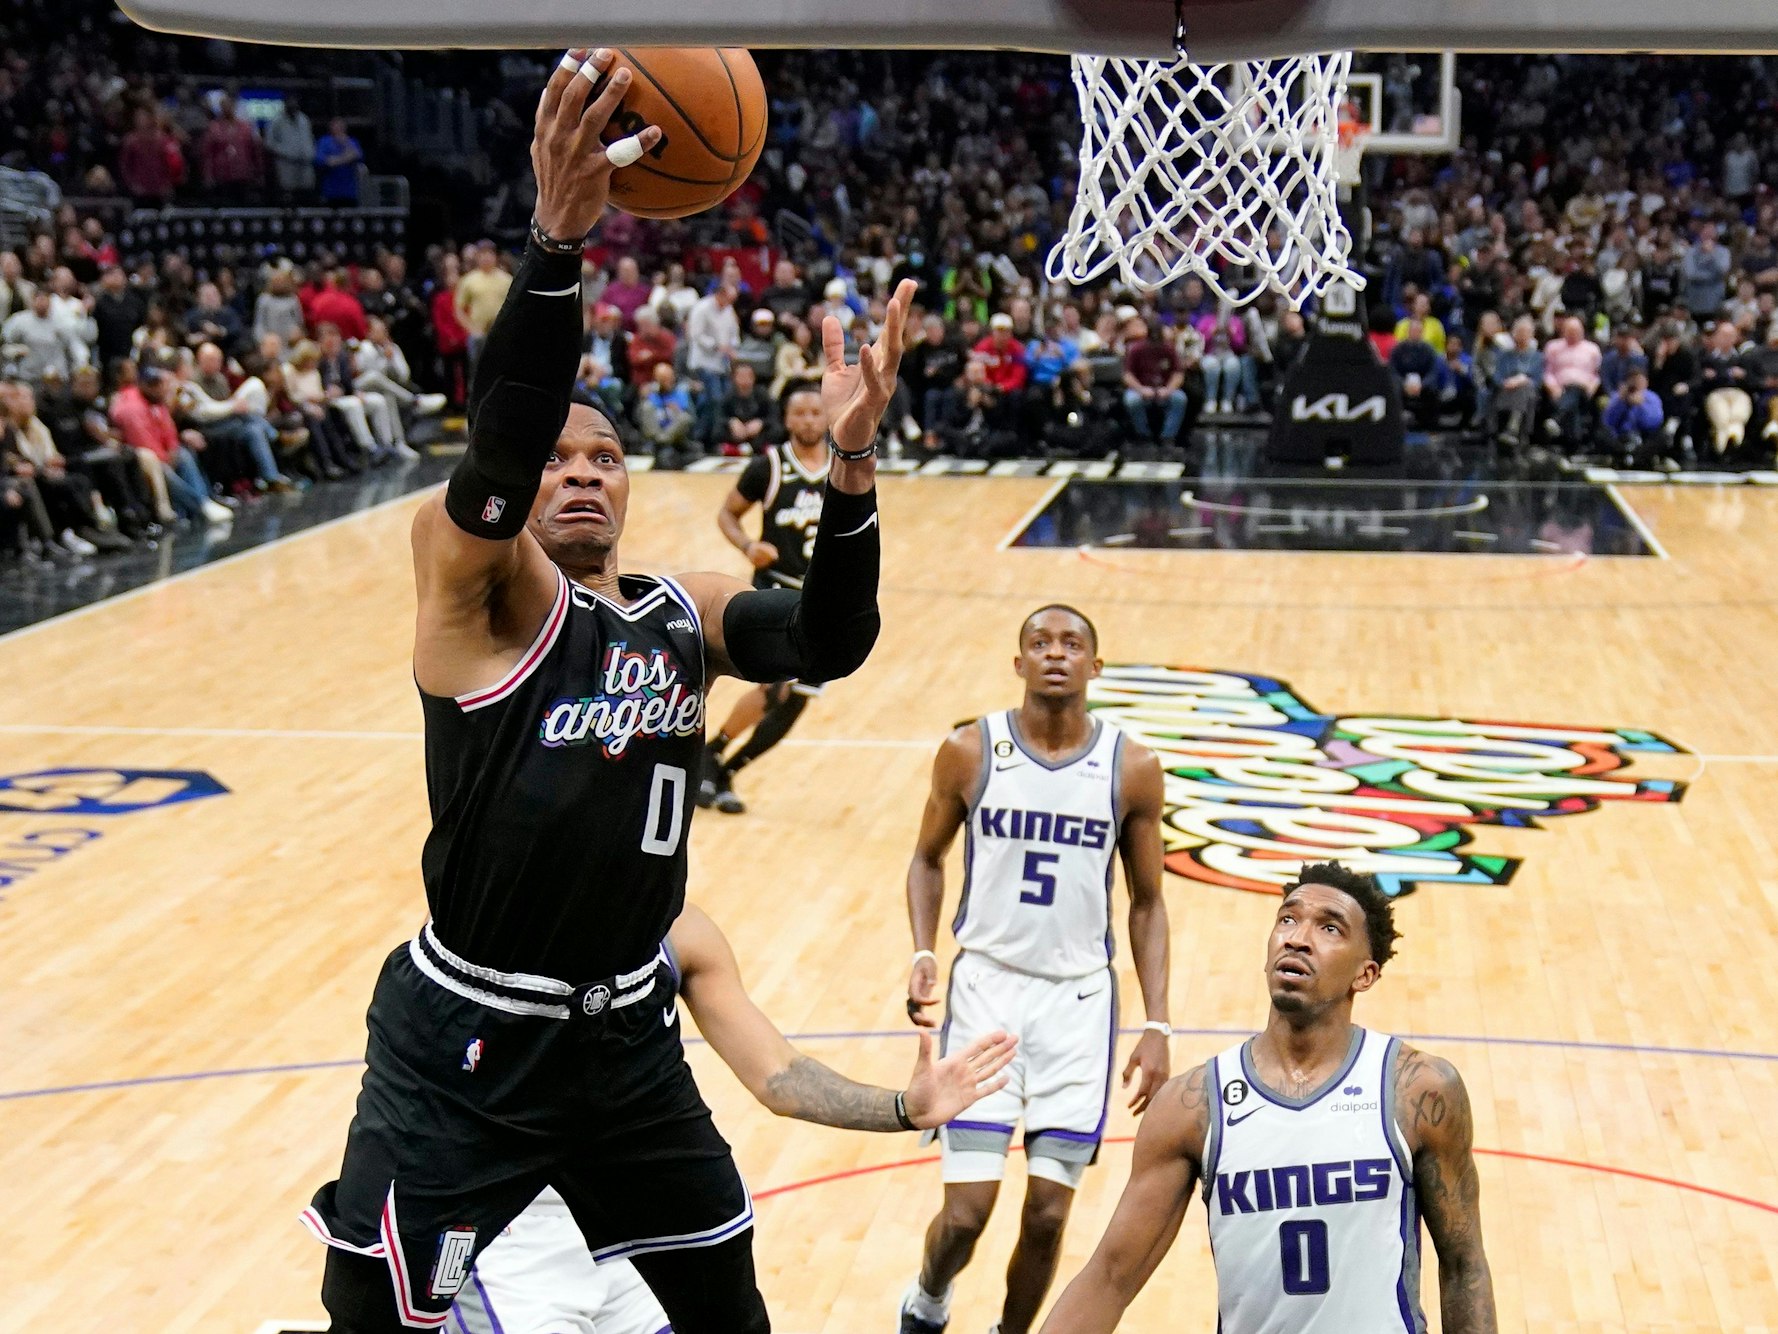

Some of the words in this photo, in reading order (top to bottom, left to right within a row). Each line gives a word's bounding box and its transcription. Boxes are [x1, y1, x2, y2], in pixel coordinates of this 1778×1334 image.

[1292, 393, 1387, 422] KIA
[603, 646, 677, 694] los
[996, 741, 1012, 758] 6
[641, 763, 687, 856] 0
[980, 806, 1111, 851] KINGS
[1019, 850, 1060, 906] 5
[1225, 1080, 1246, 1104] 6
[1330, 1101, 1378, 1114] dialpad
[1216, 1157, 1392, 1216] KINGS
[1279, 1219, 1331, 1296] 0
